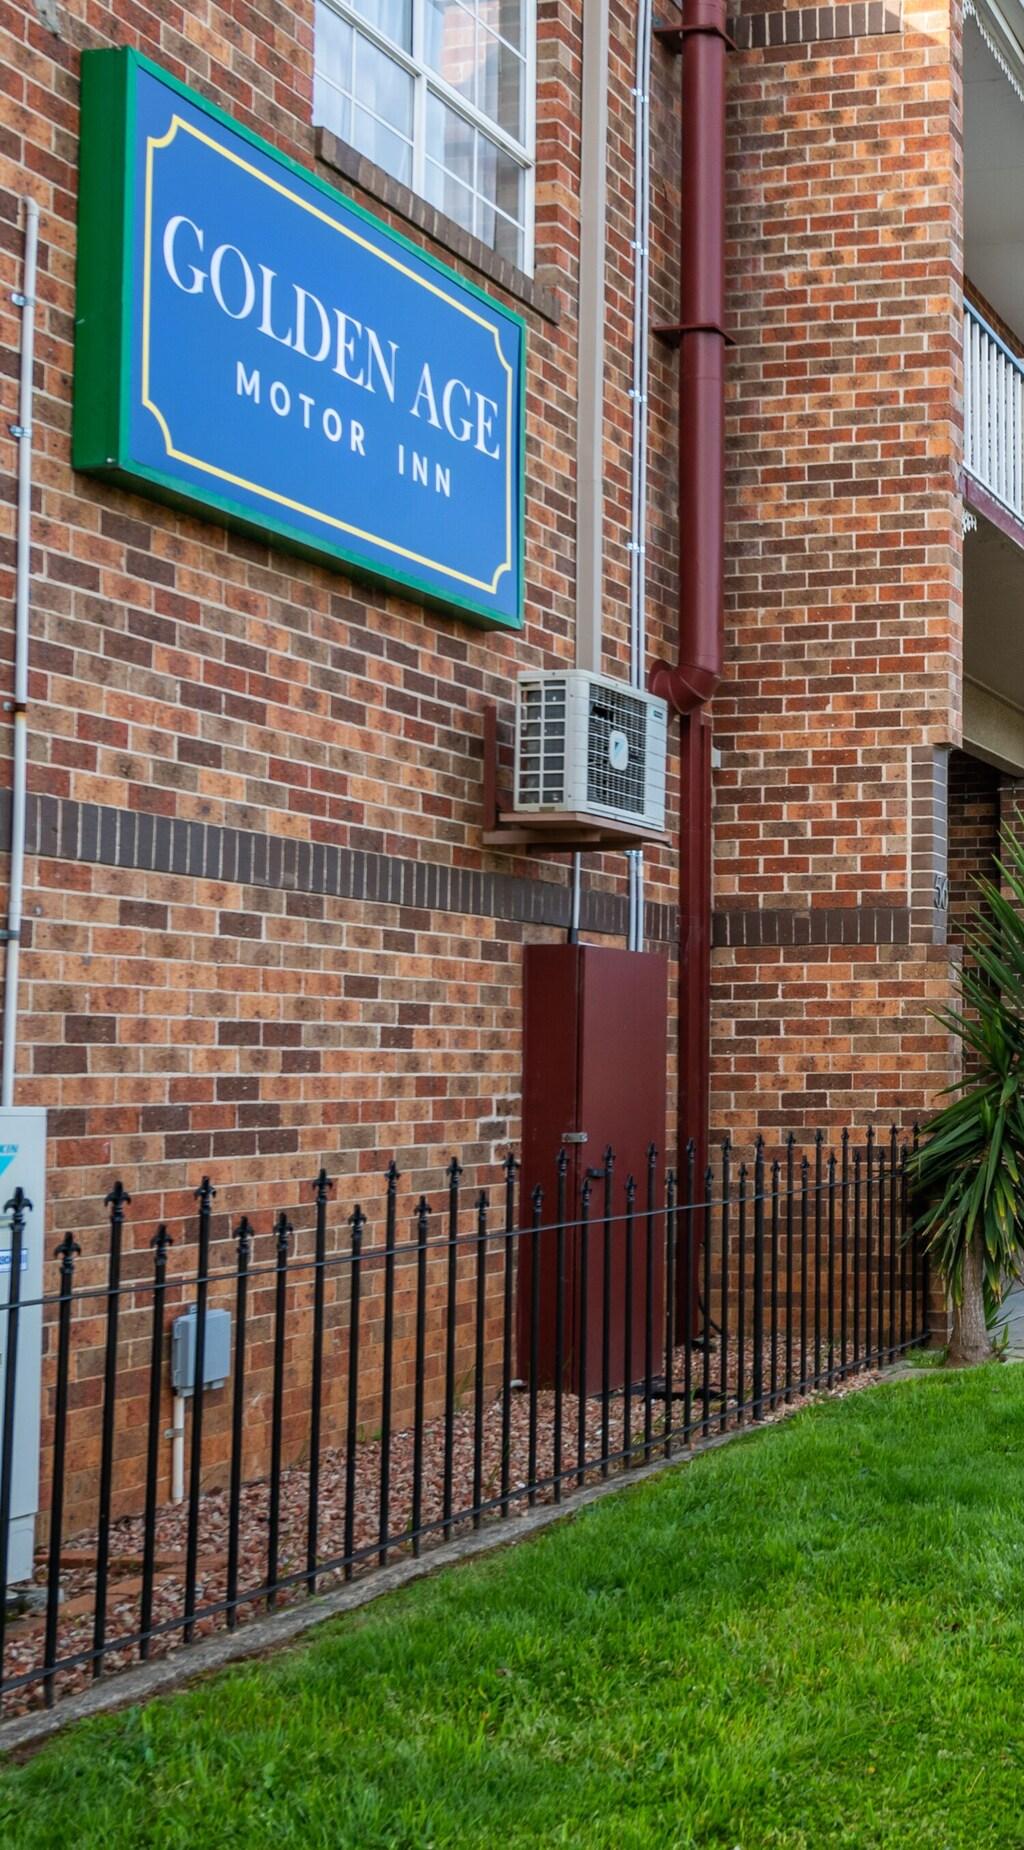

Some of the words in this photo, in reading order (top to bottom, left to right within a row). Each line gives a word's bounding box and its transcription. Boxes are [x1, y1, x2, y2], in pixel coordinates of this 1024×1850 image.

[163, 215, 399, 403] GOLDEN
[410, 363, 500, 460] AGE
[236, 361, 366, 456] MOTOR
[398, 444, 451, 497] INN
